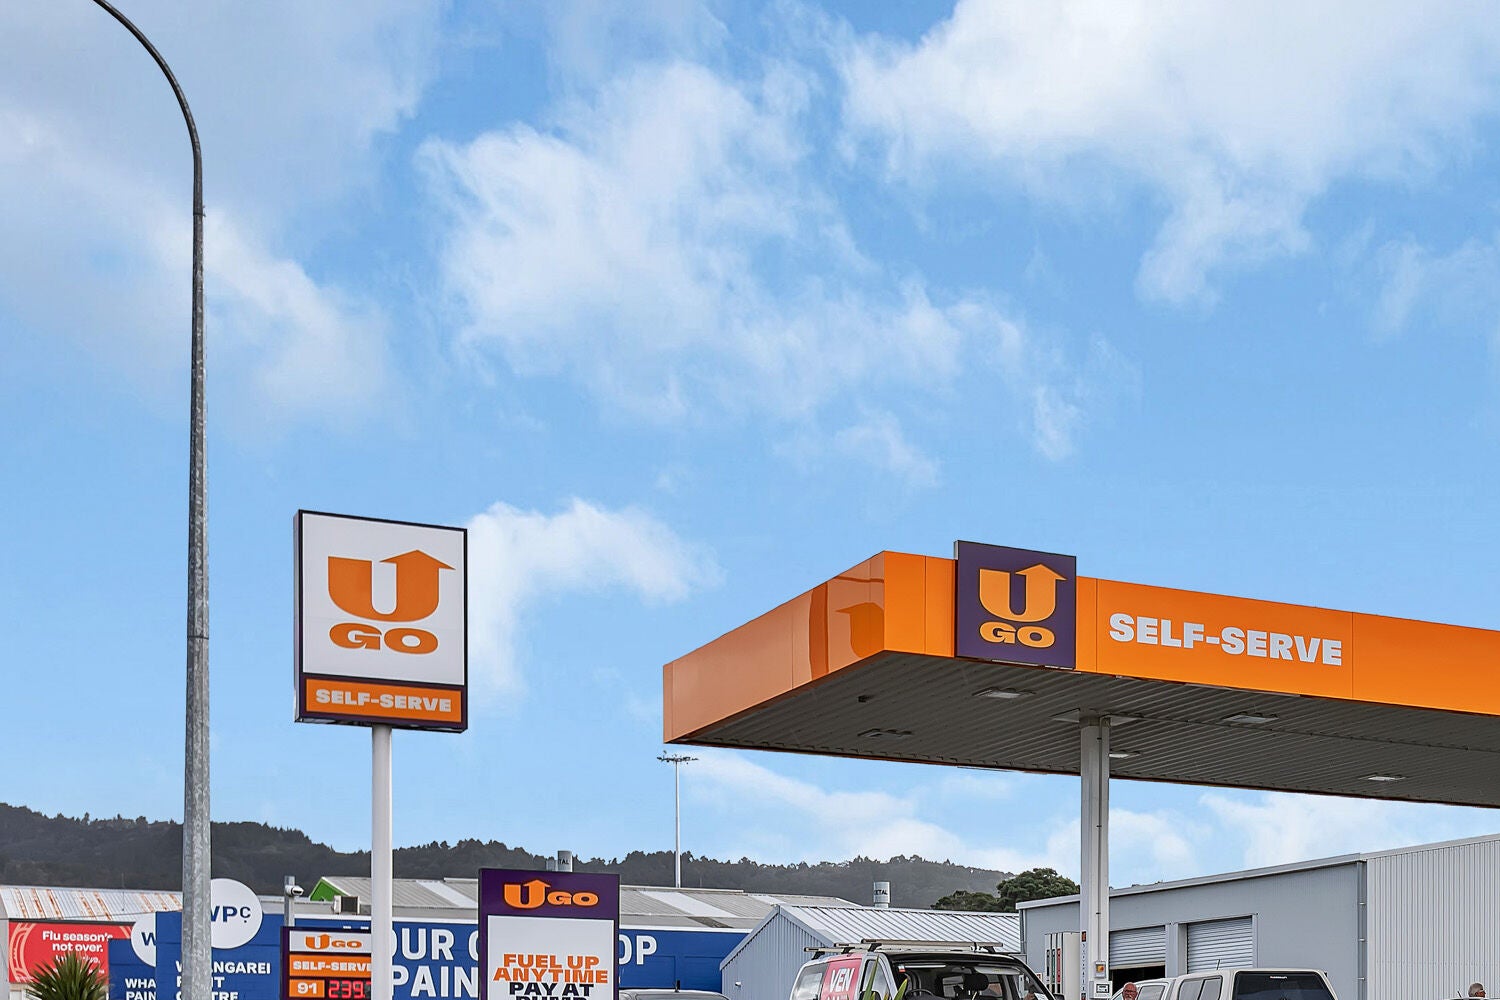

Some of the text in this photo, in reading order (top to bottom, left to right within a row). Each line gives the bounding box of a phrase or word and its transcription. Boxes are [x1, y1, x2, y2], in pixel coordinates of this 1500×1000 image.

[328, 549, 456, 622] U
[979, 563, 1067, 622] U
[329, 622, 439, 655] GO
[979, 621, 1056, 649] GO
[1109, 613, 1343, 666] SELF-SERVE
[315, 689, 451, 712] SELF-SERVE
[42, 930, 60, 941] Flu
[52, 942, 104, 953] not over.
[503, 953, 600, 970] FUEL UP
[391, 965, 478, 998] PAIN
[493, 968, 608, 984] ANYTIME
[297, 982, 318, 994] 91
[509, 983, 594, 997] PAY AT
